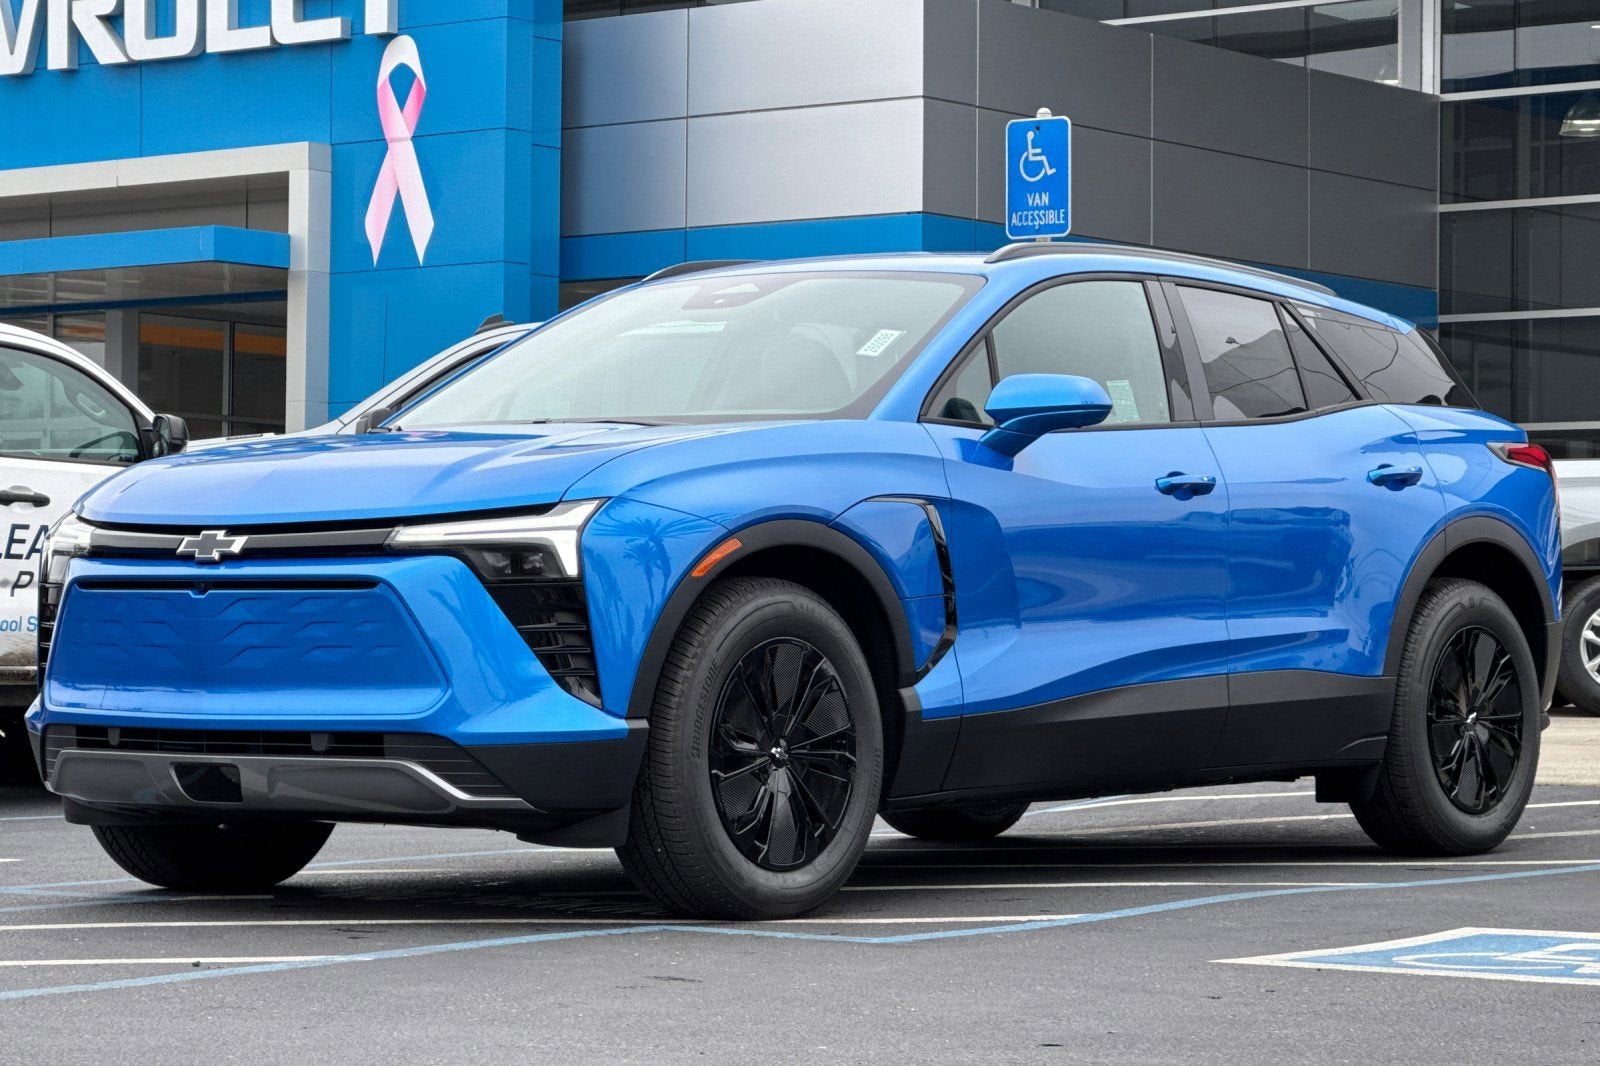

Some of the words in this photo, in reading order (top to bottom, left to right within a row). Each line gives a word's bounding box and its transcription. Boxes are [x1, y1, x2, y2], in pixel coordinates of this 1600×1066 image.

[1027, 192, 1049, 207] VAN
[1011, 209, 1065, 227] ACCESSIBLE
[0, 523, 49, 560] EA
[691, 660, 719, 759] BRIDGESTONE
